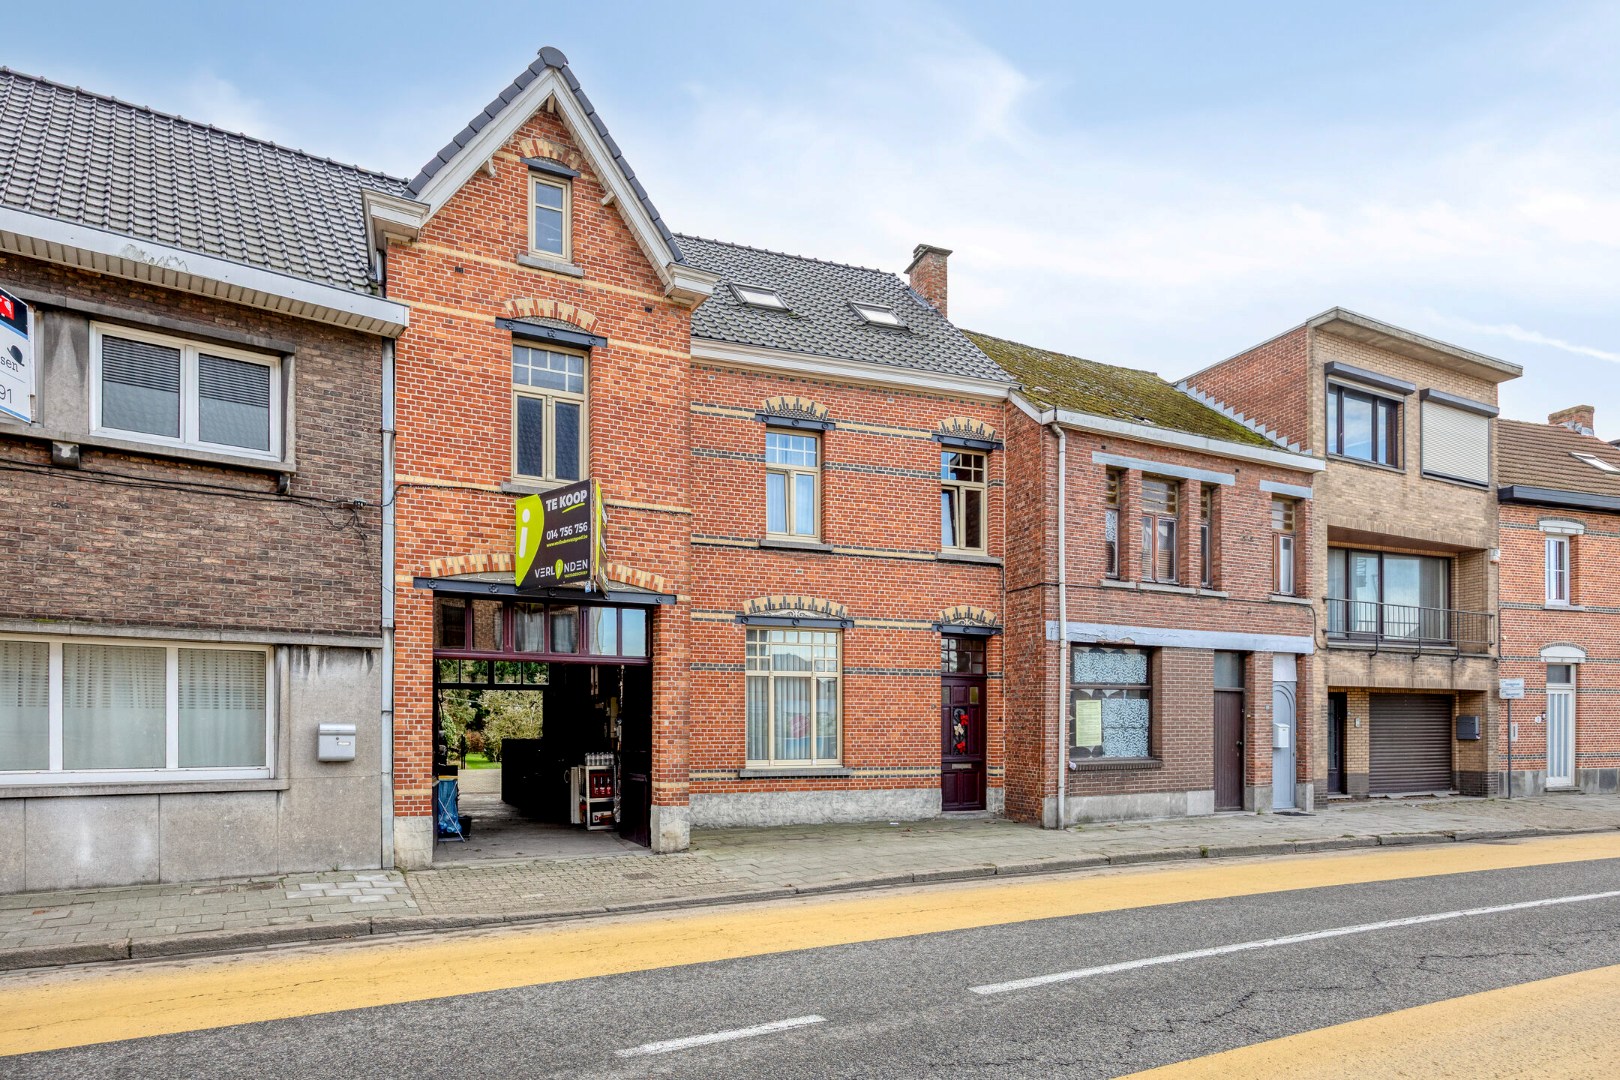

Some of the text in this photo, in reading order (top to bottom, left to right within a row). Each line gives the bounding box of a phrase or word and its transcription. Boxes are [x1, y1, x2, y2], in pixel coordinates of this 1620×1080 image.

[1, 356, 19, 372] sen
[546, 490, 587, 511] TE KOOP
[547, 522, 588, 540] 014 756 756
